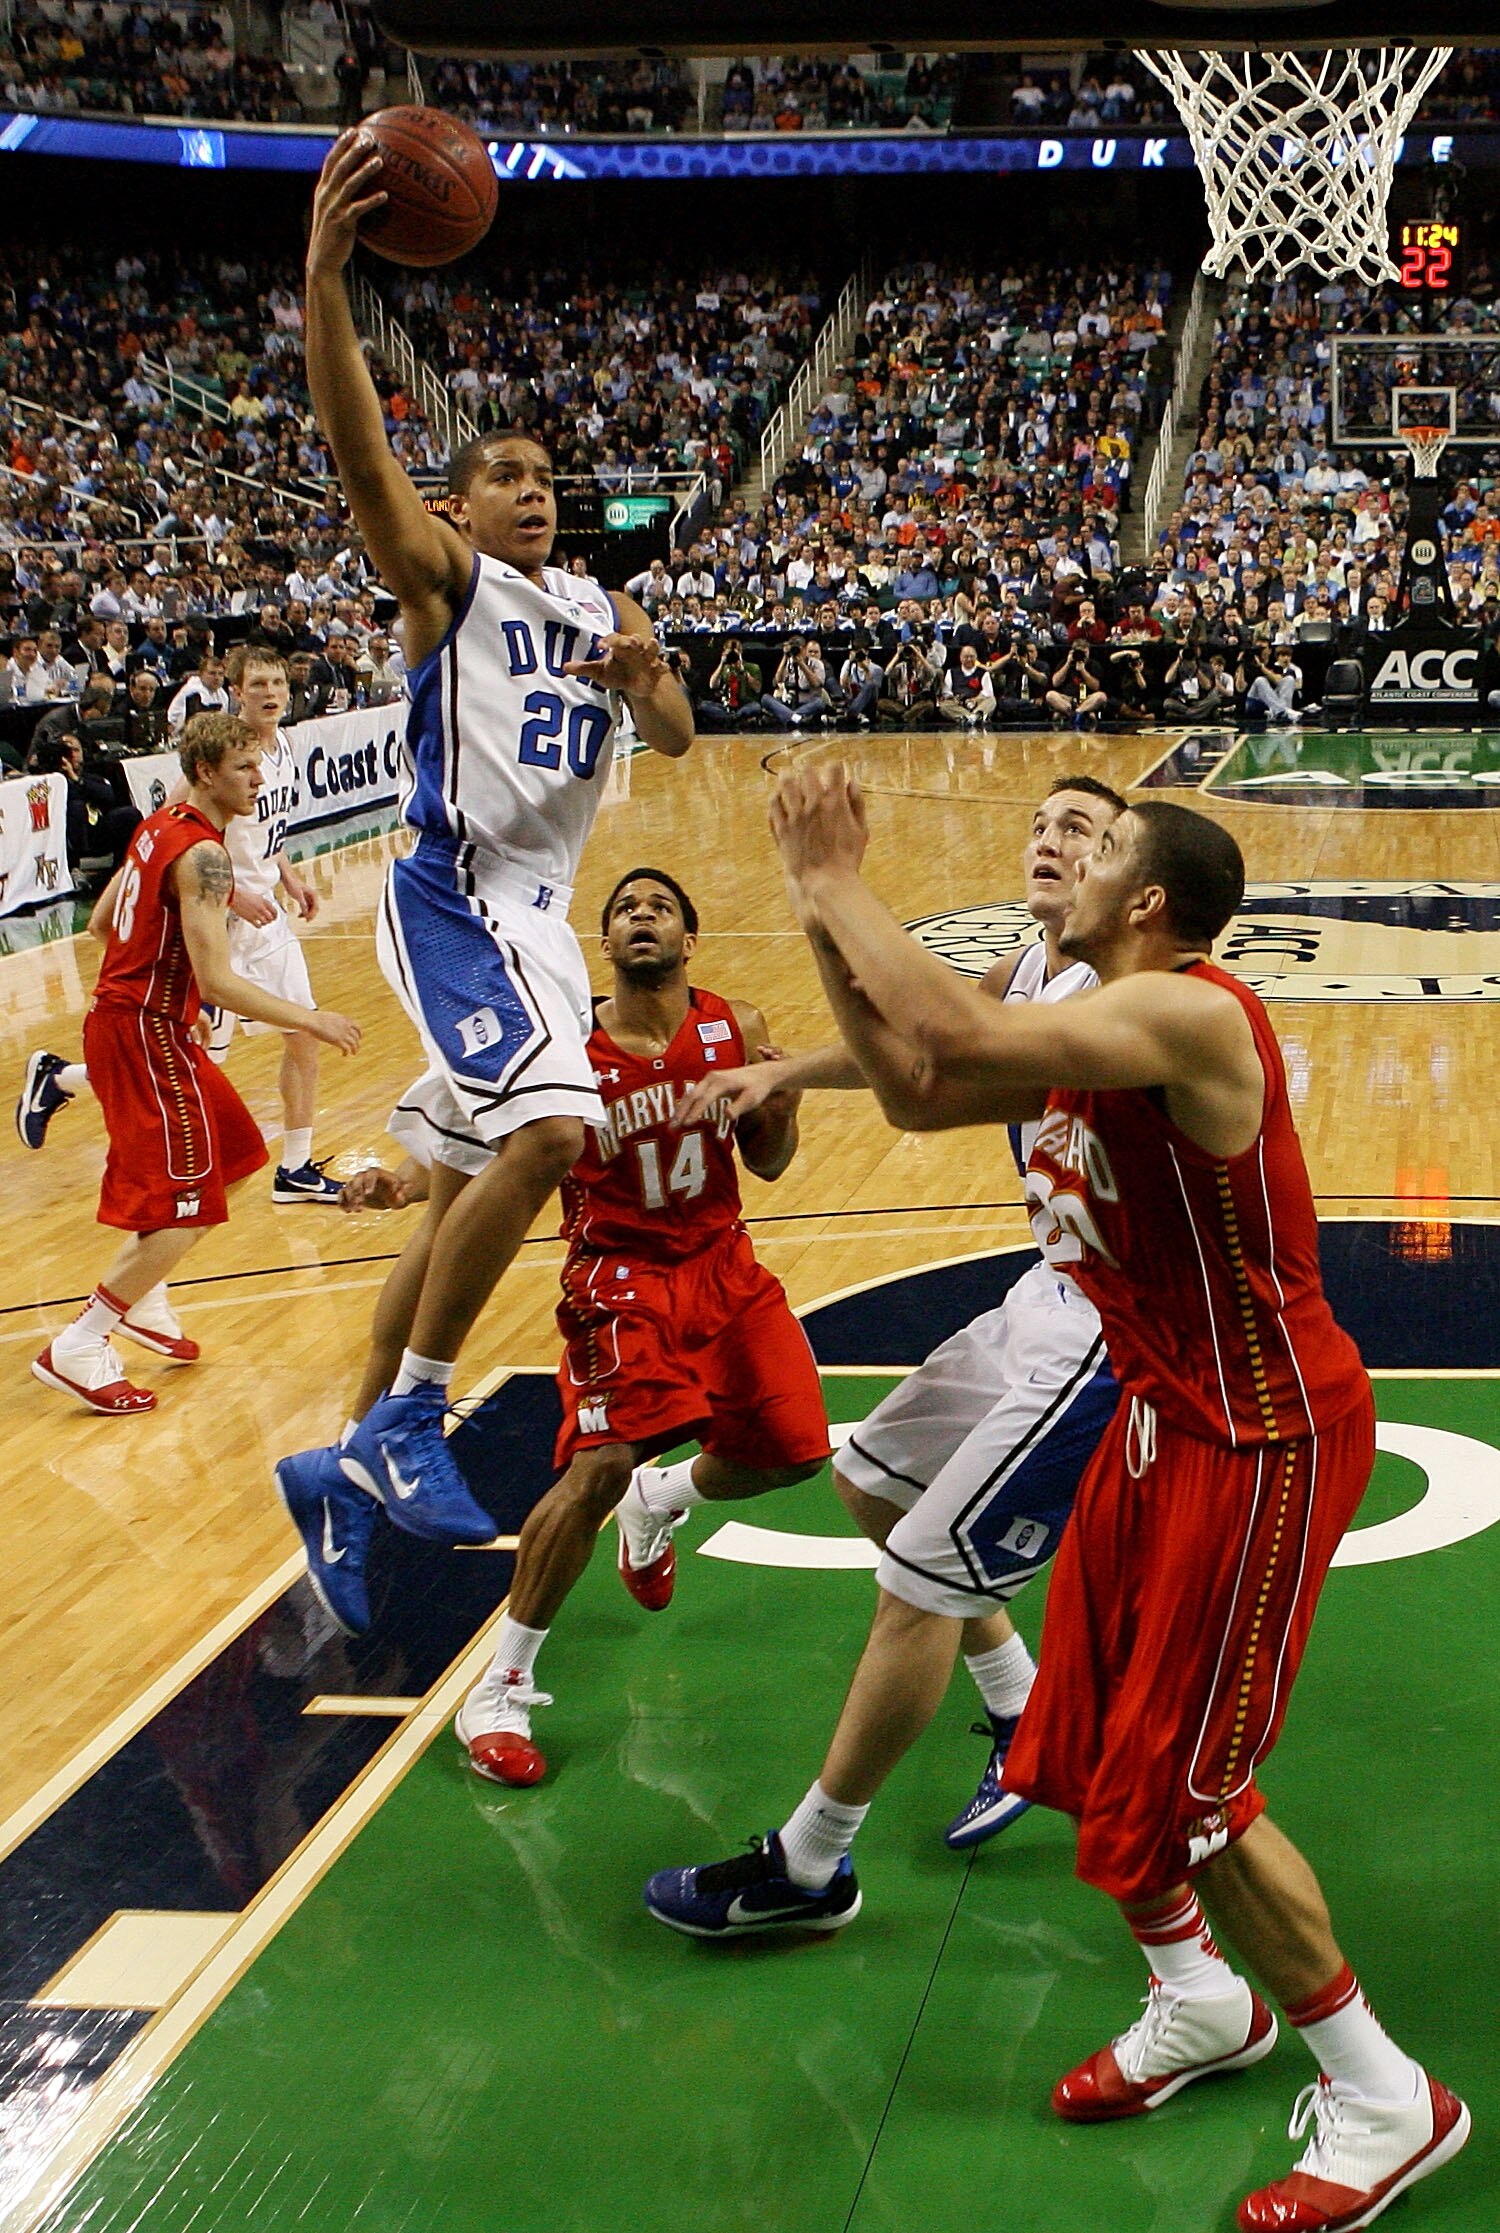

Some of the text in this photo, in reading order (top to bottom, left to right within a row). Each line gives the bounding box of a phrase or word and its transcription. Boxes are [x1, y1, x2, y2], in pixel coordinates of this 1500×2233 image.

[1402, 225, 1459, 249] 11:24
[1401, 248, 1452, 288] 22
[425, 499, 450, 512] LAND
[1371, 649, 1479, 690] ACC
[518, 690, 613, 780] 20
[306, 738, 378, 799] Coast
[263, 818, 288, 860] 12
[112, 857, 141, 943] 13
[1220, 922, 1322, 963] ACC
[634, 1130, 709, 1211] 14
